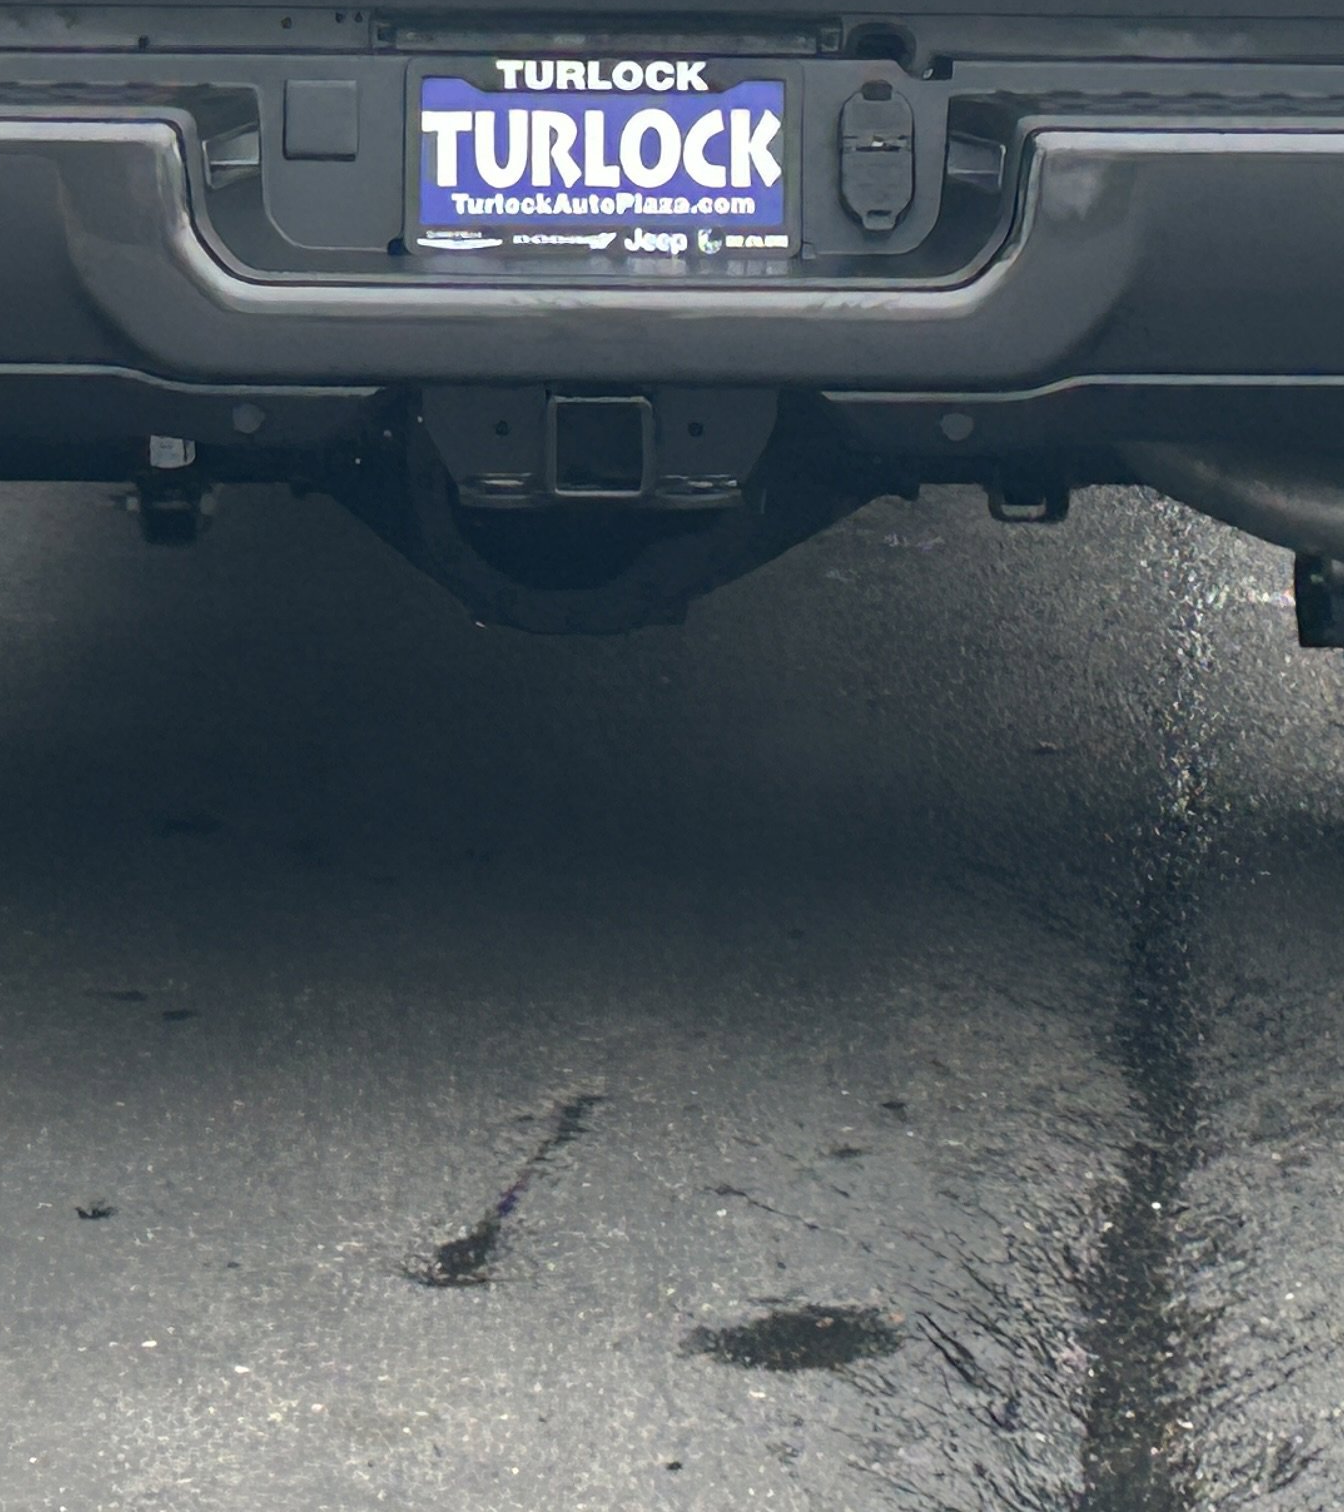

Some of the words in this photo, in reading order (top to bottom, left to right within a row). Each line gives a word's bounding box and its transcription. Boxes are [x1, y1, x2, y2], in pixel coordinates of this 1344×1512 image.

[496, 59, 709, 91] TURLOCK
[421, 108, 782, 189] TURLOCK
[451, 192, 755, 215] TurlockAutoPlaza.com
[624, 227, 688, 254] Jeep
